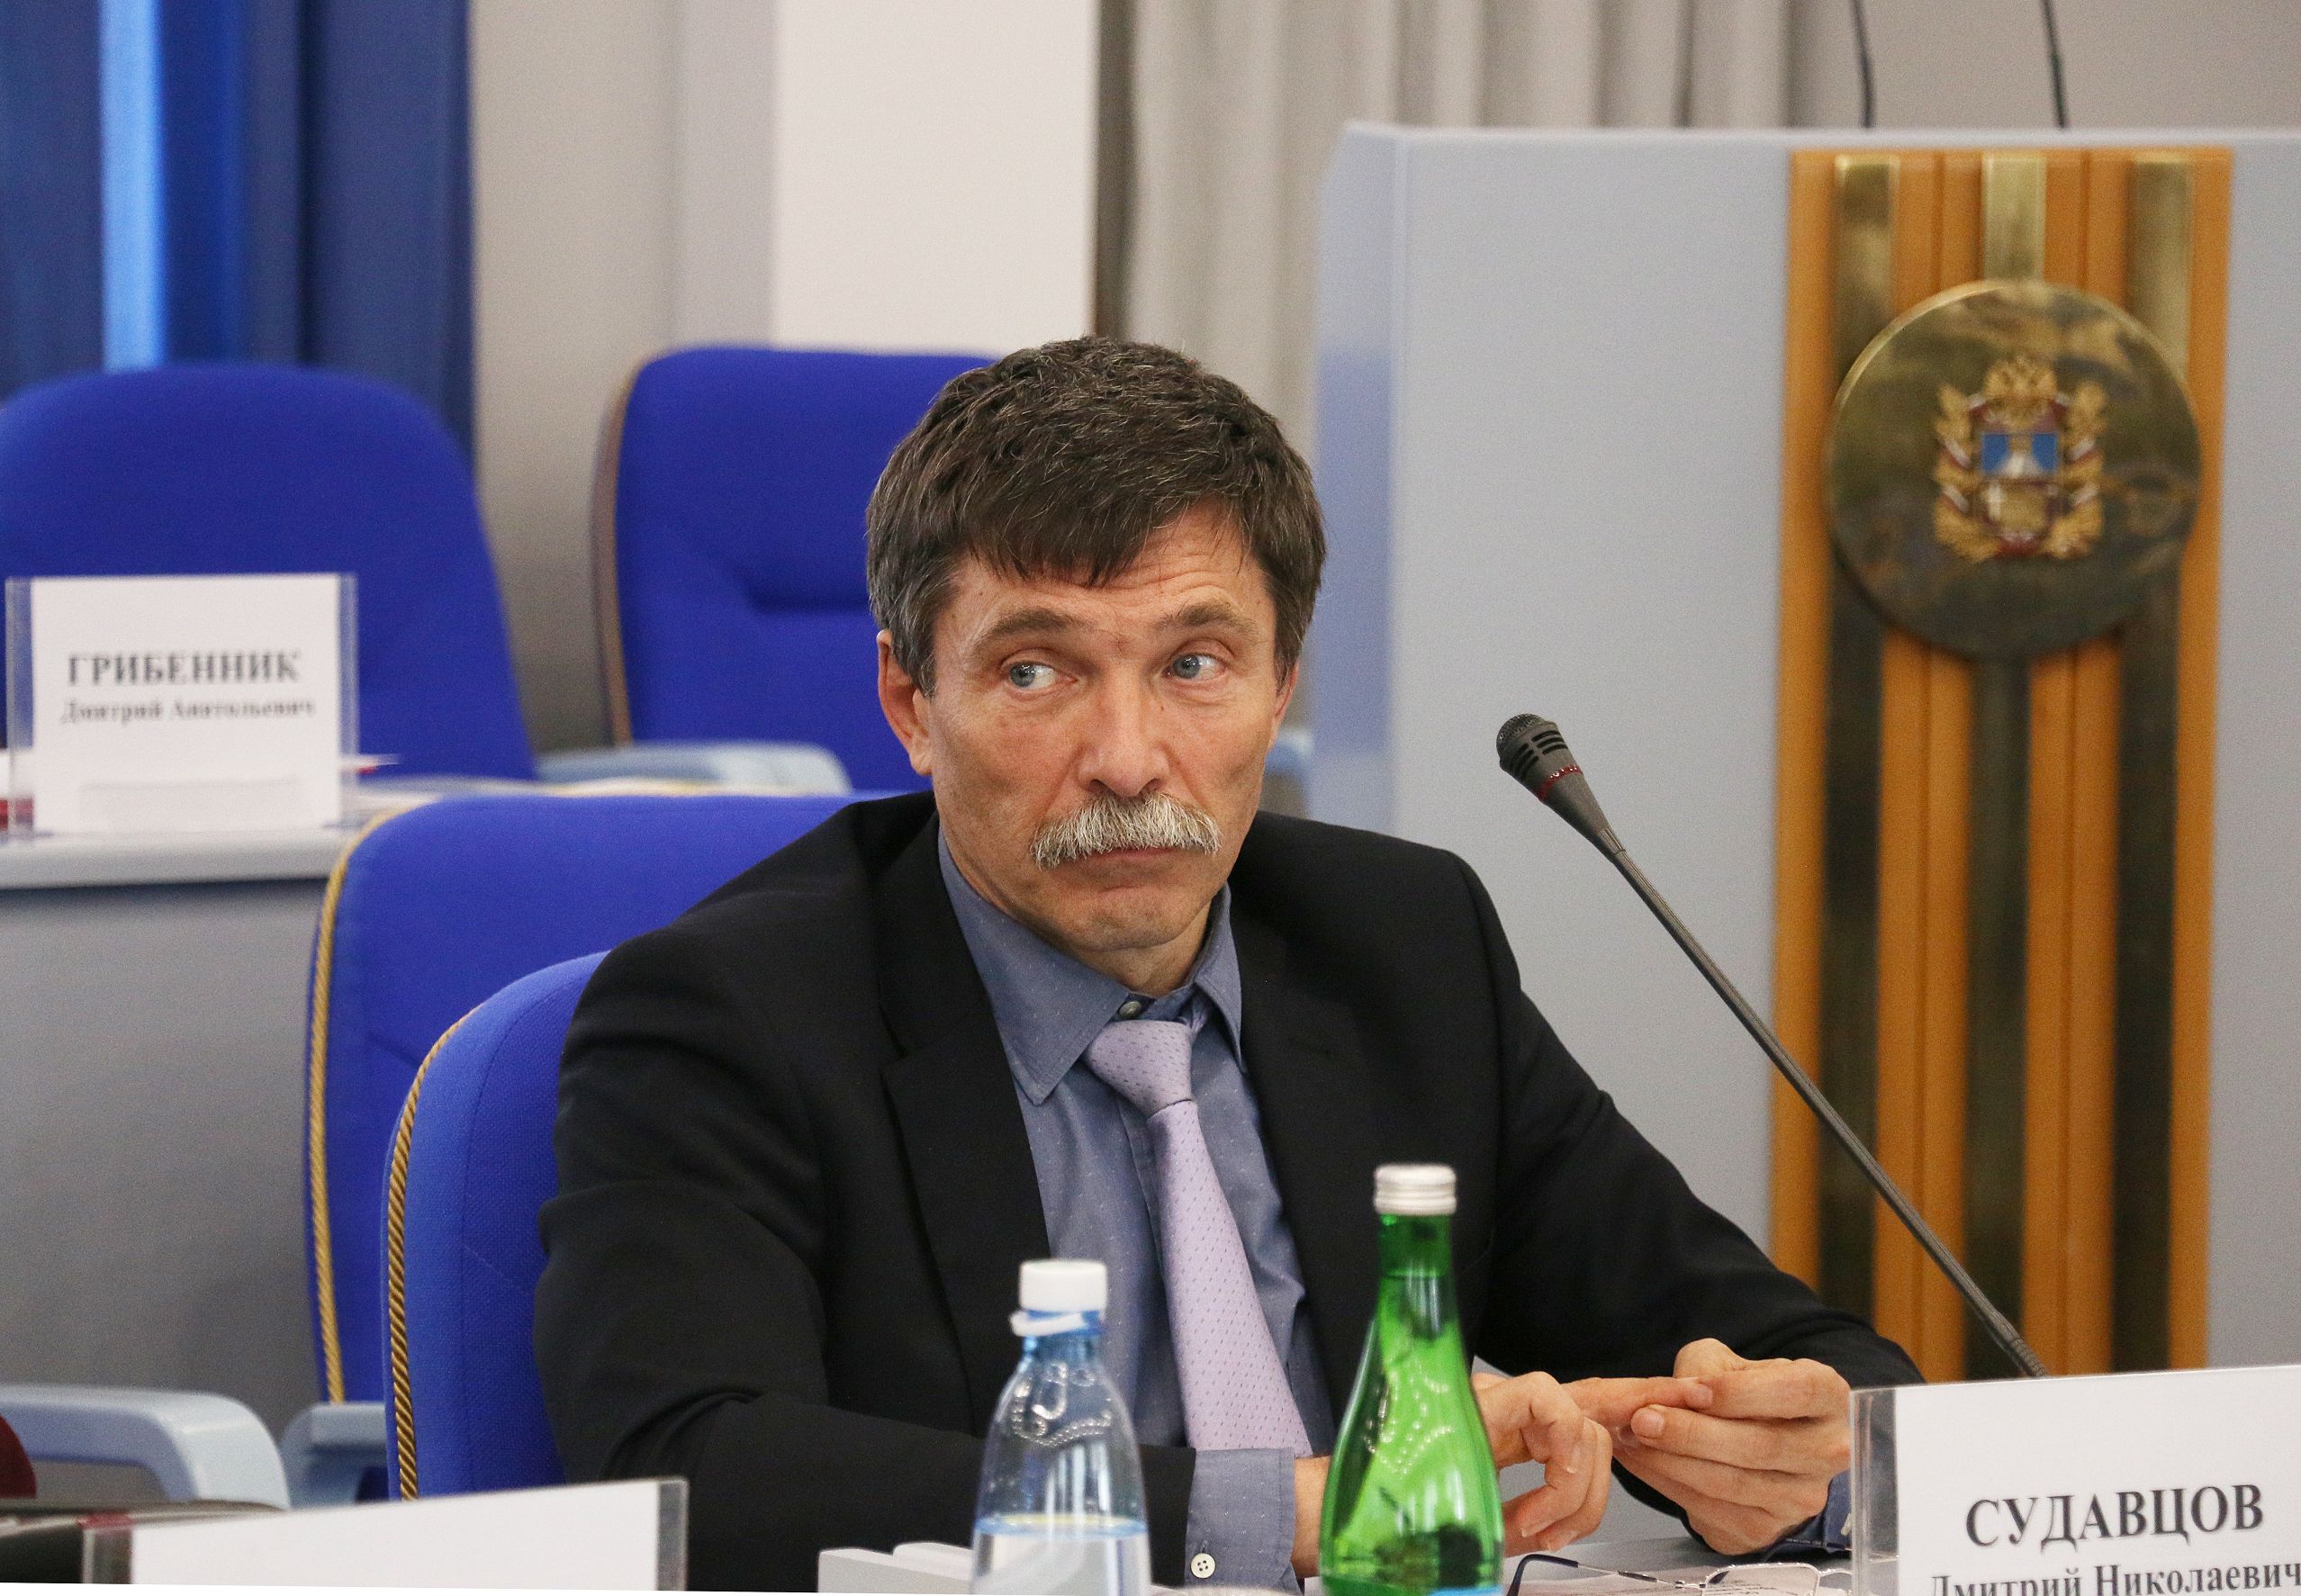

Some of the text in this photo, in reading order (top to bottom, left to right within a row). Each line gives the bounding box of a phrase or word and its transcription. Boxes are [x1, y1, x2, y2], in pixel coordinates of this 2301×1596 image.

[68, 650, 300, 685] ГРИБЕННИК
[60, 699, 163, 726] Дмитрий
[1965, 1483, 2264, 1554] СУДАВЦОВ
[2093, 1563, 2301, 1596] Николаевич
